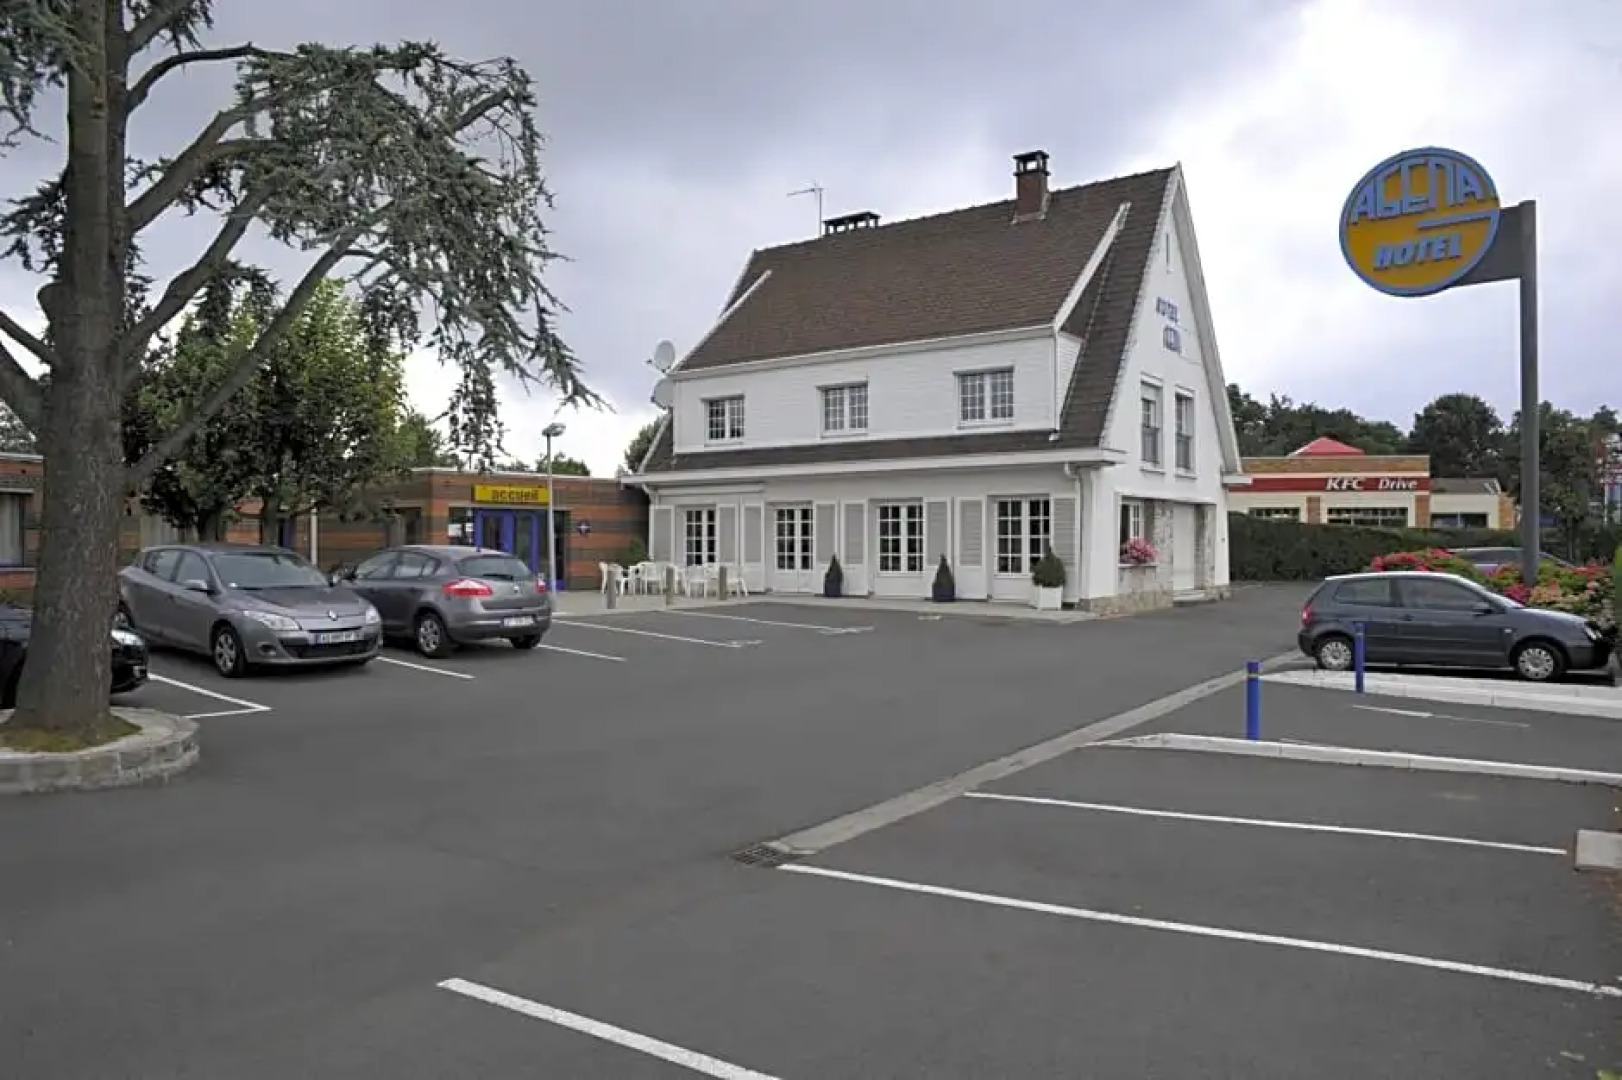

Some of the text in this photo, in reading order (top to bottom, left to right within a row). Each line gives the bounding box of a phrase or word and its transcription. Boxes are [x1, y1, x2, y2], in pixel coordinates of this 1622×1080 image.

[1373, 234, 1462, 270] HOTEL
[1326, 476, 1417, 490] KFC Drive
